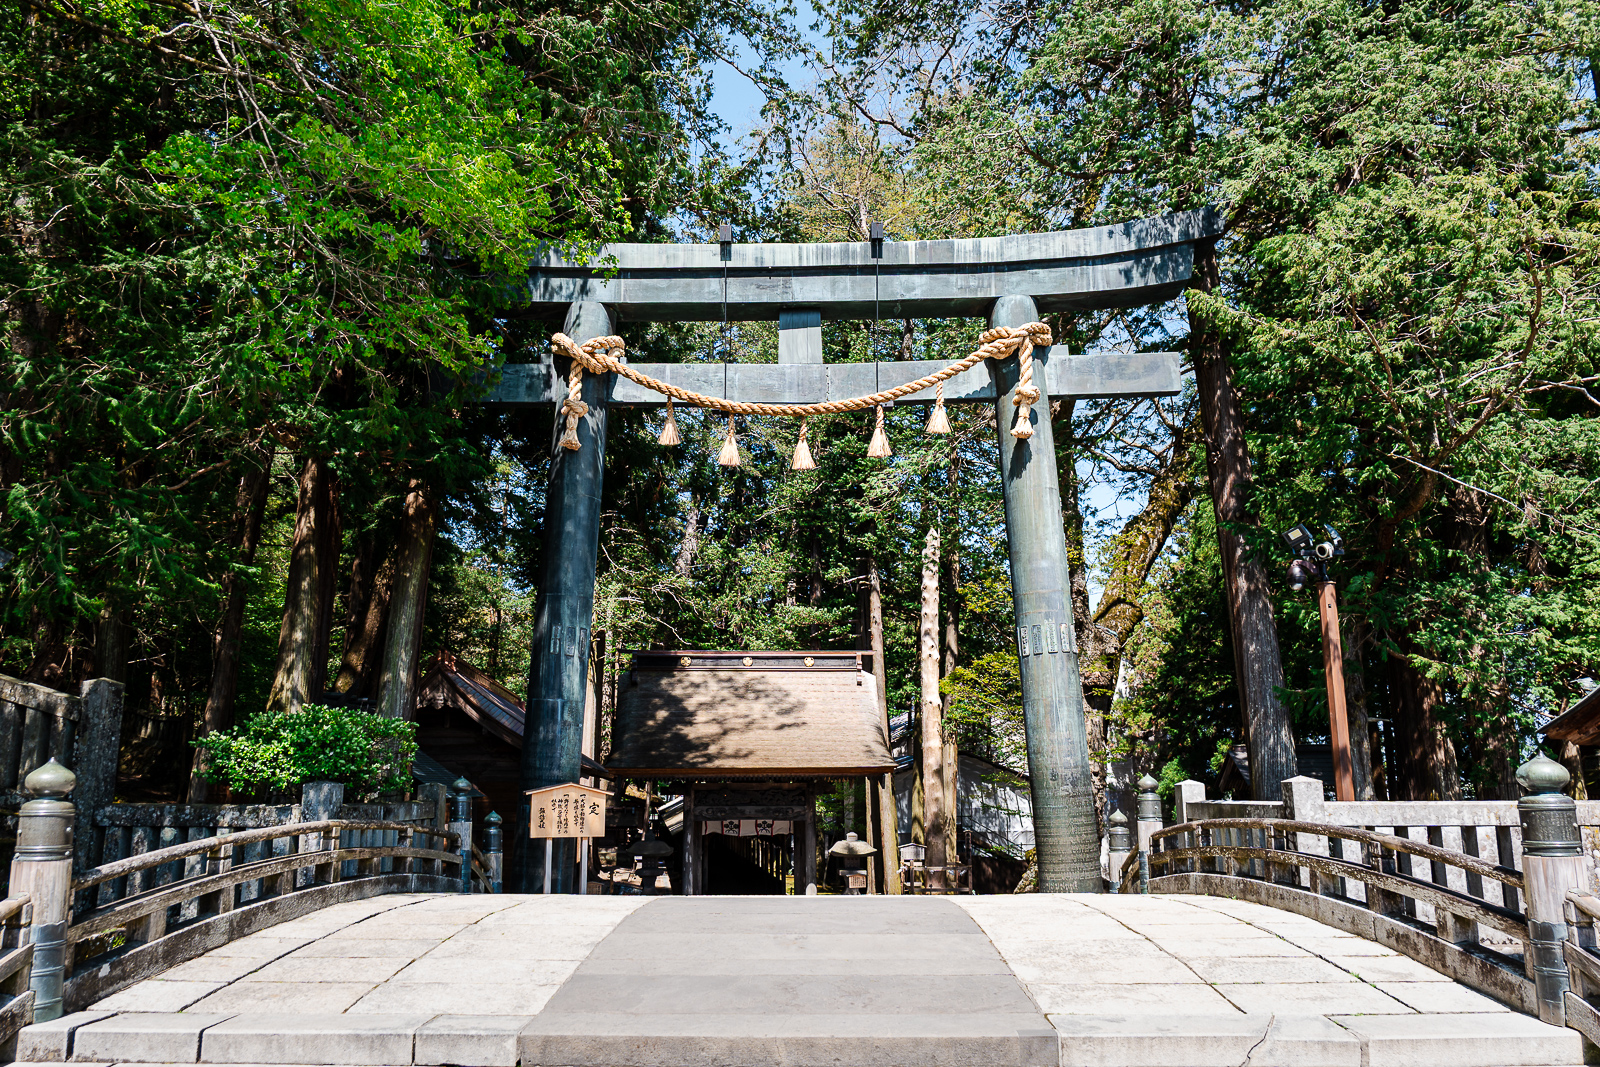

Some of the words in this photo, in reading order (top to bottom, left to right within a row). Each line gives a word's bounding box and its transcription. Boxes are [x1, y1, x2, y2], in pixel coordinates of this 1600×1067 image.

[589, 802, 599, 815] 定
[538, 807, 546, 829] 諏訪大社
